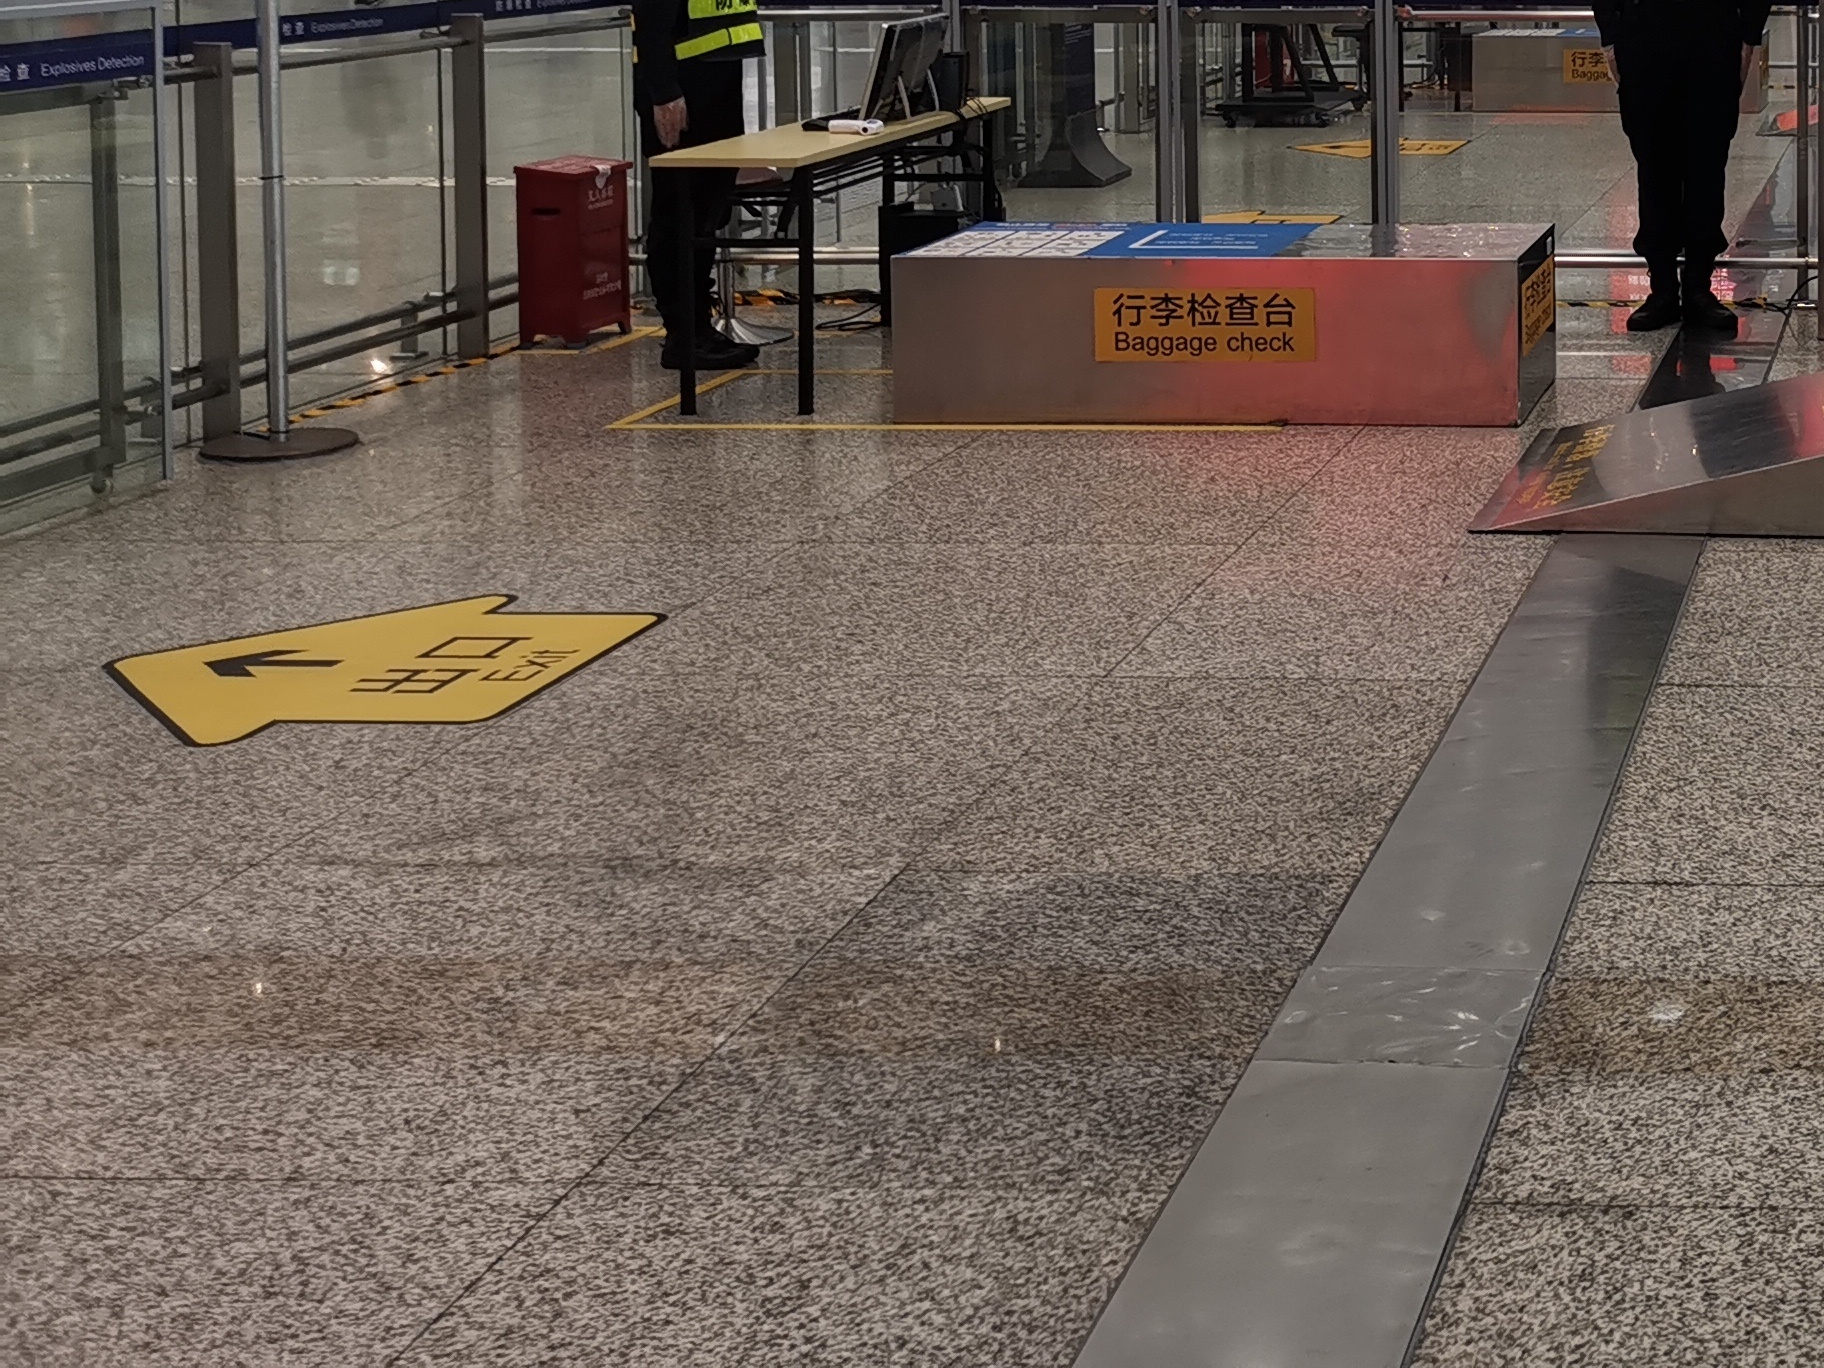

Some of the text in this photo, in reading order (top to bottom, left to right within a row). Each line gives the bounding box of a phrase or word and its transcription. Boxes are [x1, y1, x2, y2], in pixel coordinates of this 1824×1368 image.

[40, 54, 145, 77] Explosives Detection
[1571, 51, 1607, 67] 行李
[1112, 292, 1296, 328] 行李检查台
[1114, 332, 1295, 356] Baggage check
[349, 636, 534, 694] 出口
[478, 648, 581, 682] Exit
